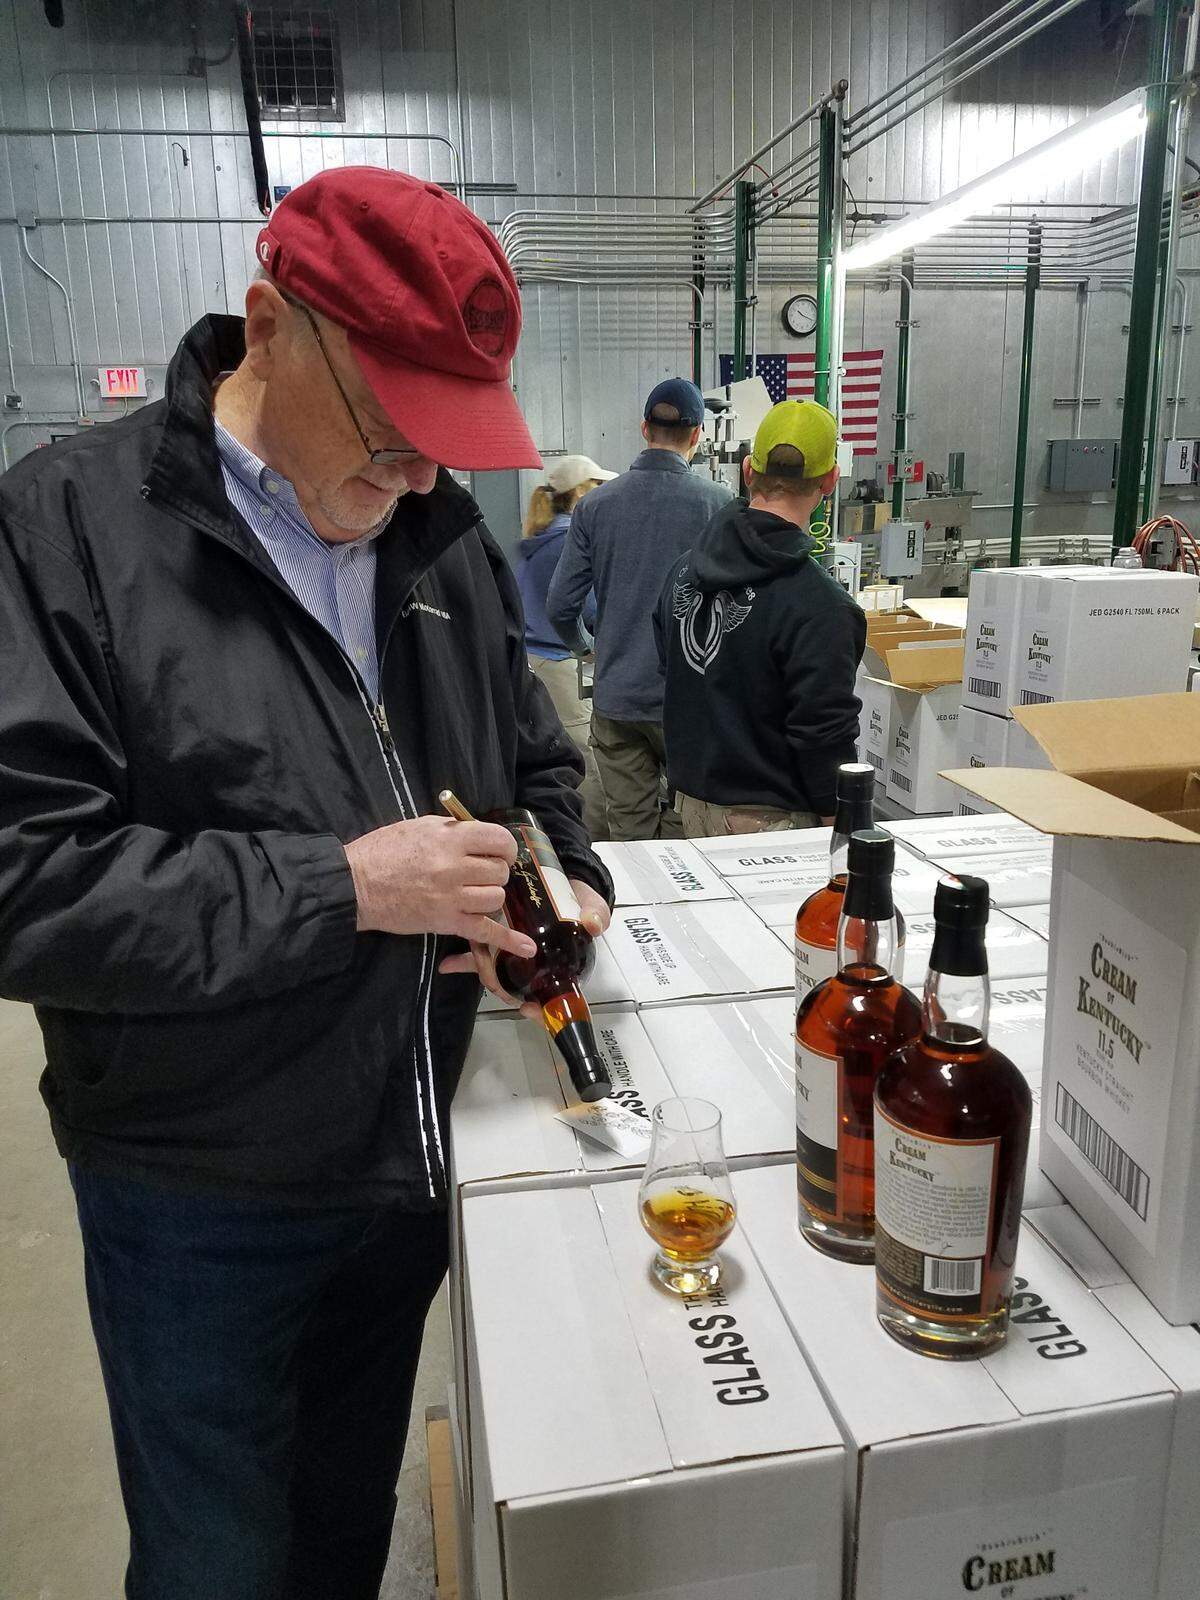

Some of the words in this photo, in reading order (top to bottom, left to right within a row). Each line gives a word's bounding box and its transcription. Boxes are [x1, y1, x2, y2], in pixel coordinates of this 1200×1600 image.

[106, 369, 138, 393] EXIT
[1088, 608, 1102, 616] JED
[1103, 608, 1124, 616] G2540
[1134, 607, 1155, 615] 750ML
[1162, 607, 1180, 615] PACK
[938, 837, 997, 848] GLASS
[739, 856, 797, 867] GLASS
[669, 871, 705, 891] GLASS
[624, 917, 661, 944] GLASS
[1091, 942, 1138, 1006] CREAM
[1077, 976, 1144, 1065] KENTUCKY
[600, 1029, 618, 1046] CARE
[1098, 1030, 1115, 1059] 11.5
[608, 1046, 625, 1061] WITH
[614, 1061, 635, 1088] HANDLE
[895, 1138, 926, 1161] CREAM
[890, 1150, 934, 1182] KENTUCKY
[688, 1314, 770, 1406] GLASS
[962, 1550, 1056, 1592] CREAM
